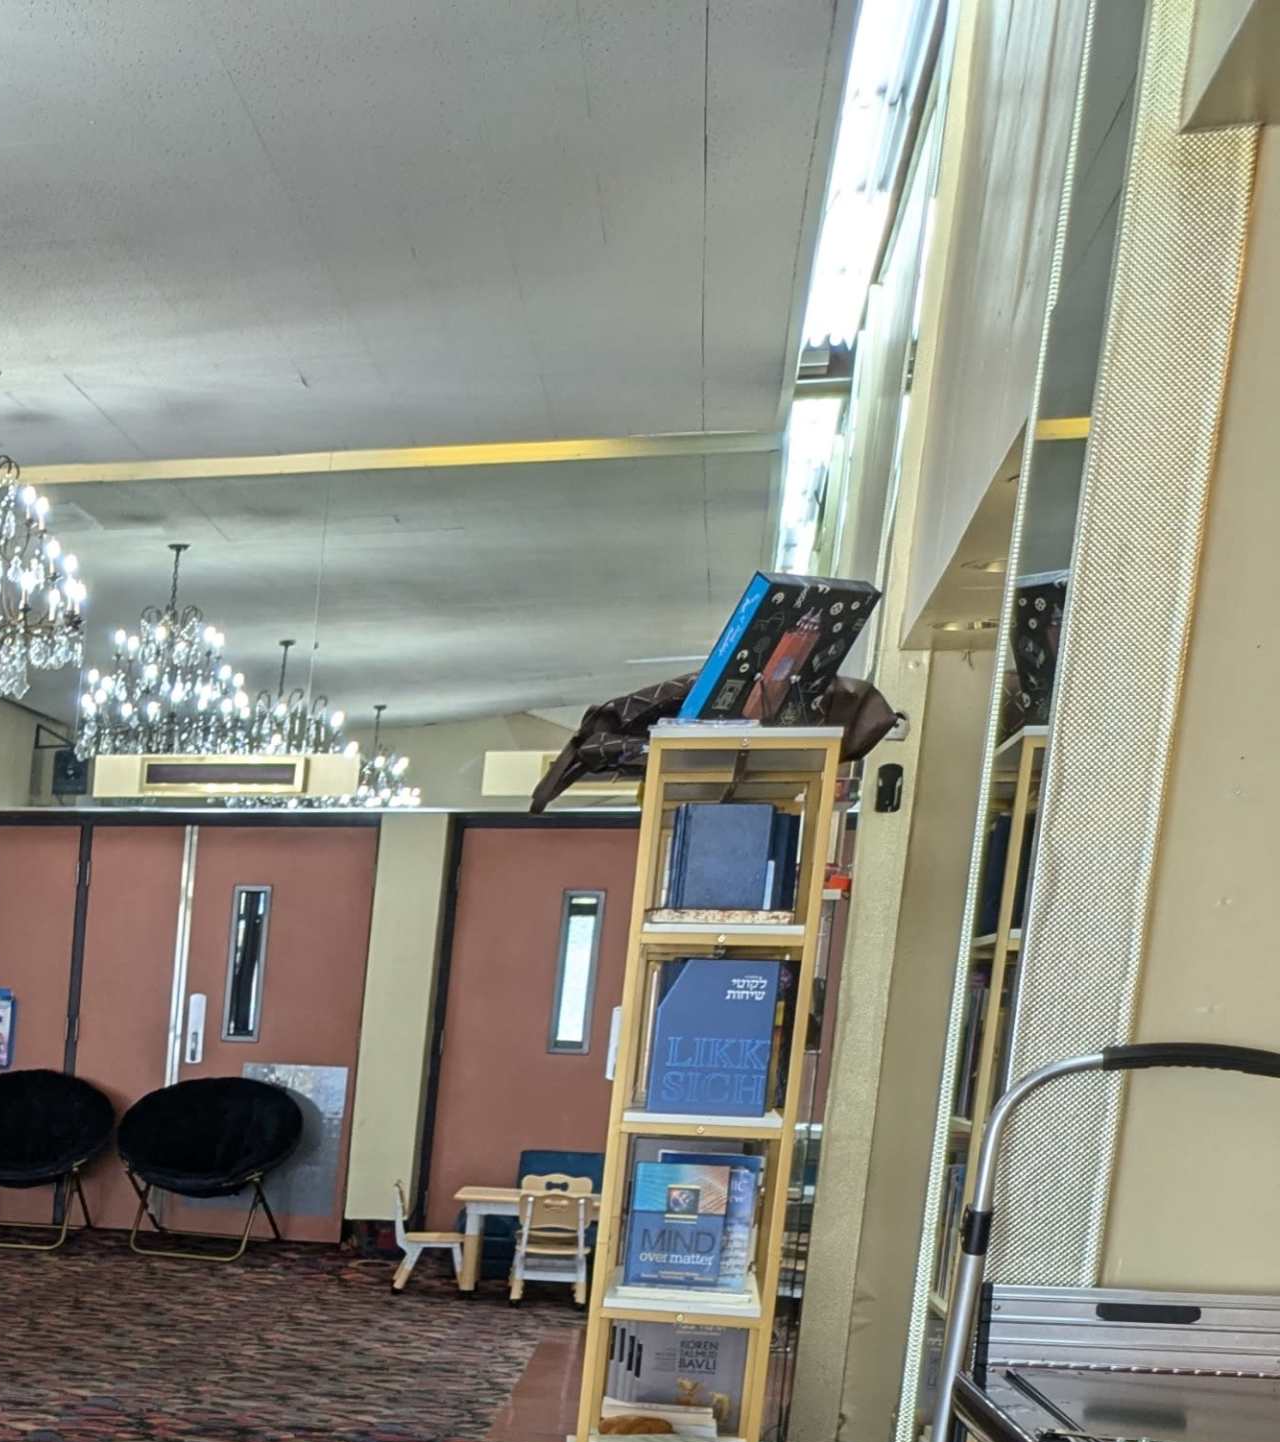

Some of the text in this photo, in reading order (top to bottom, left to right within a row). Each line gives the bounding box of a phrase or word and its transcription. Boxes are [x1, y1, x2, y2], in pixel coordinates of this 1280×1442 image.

[641, 1228, 717, 1254] MIND
[639, 1253, 714, 1266] over matter
[680, 1340, 719, 1351] KOREN
[678, 1358, 717, 1371] BAVLI
